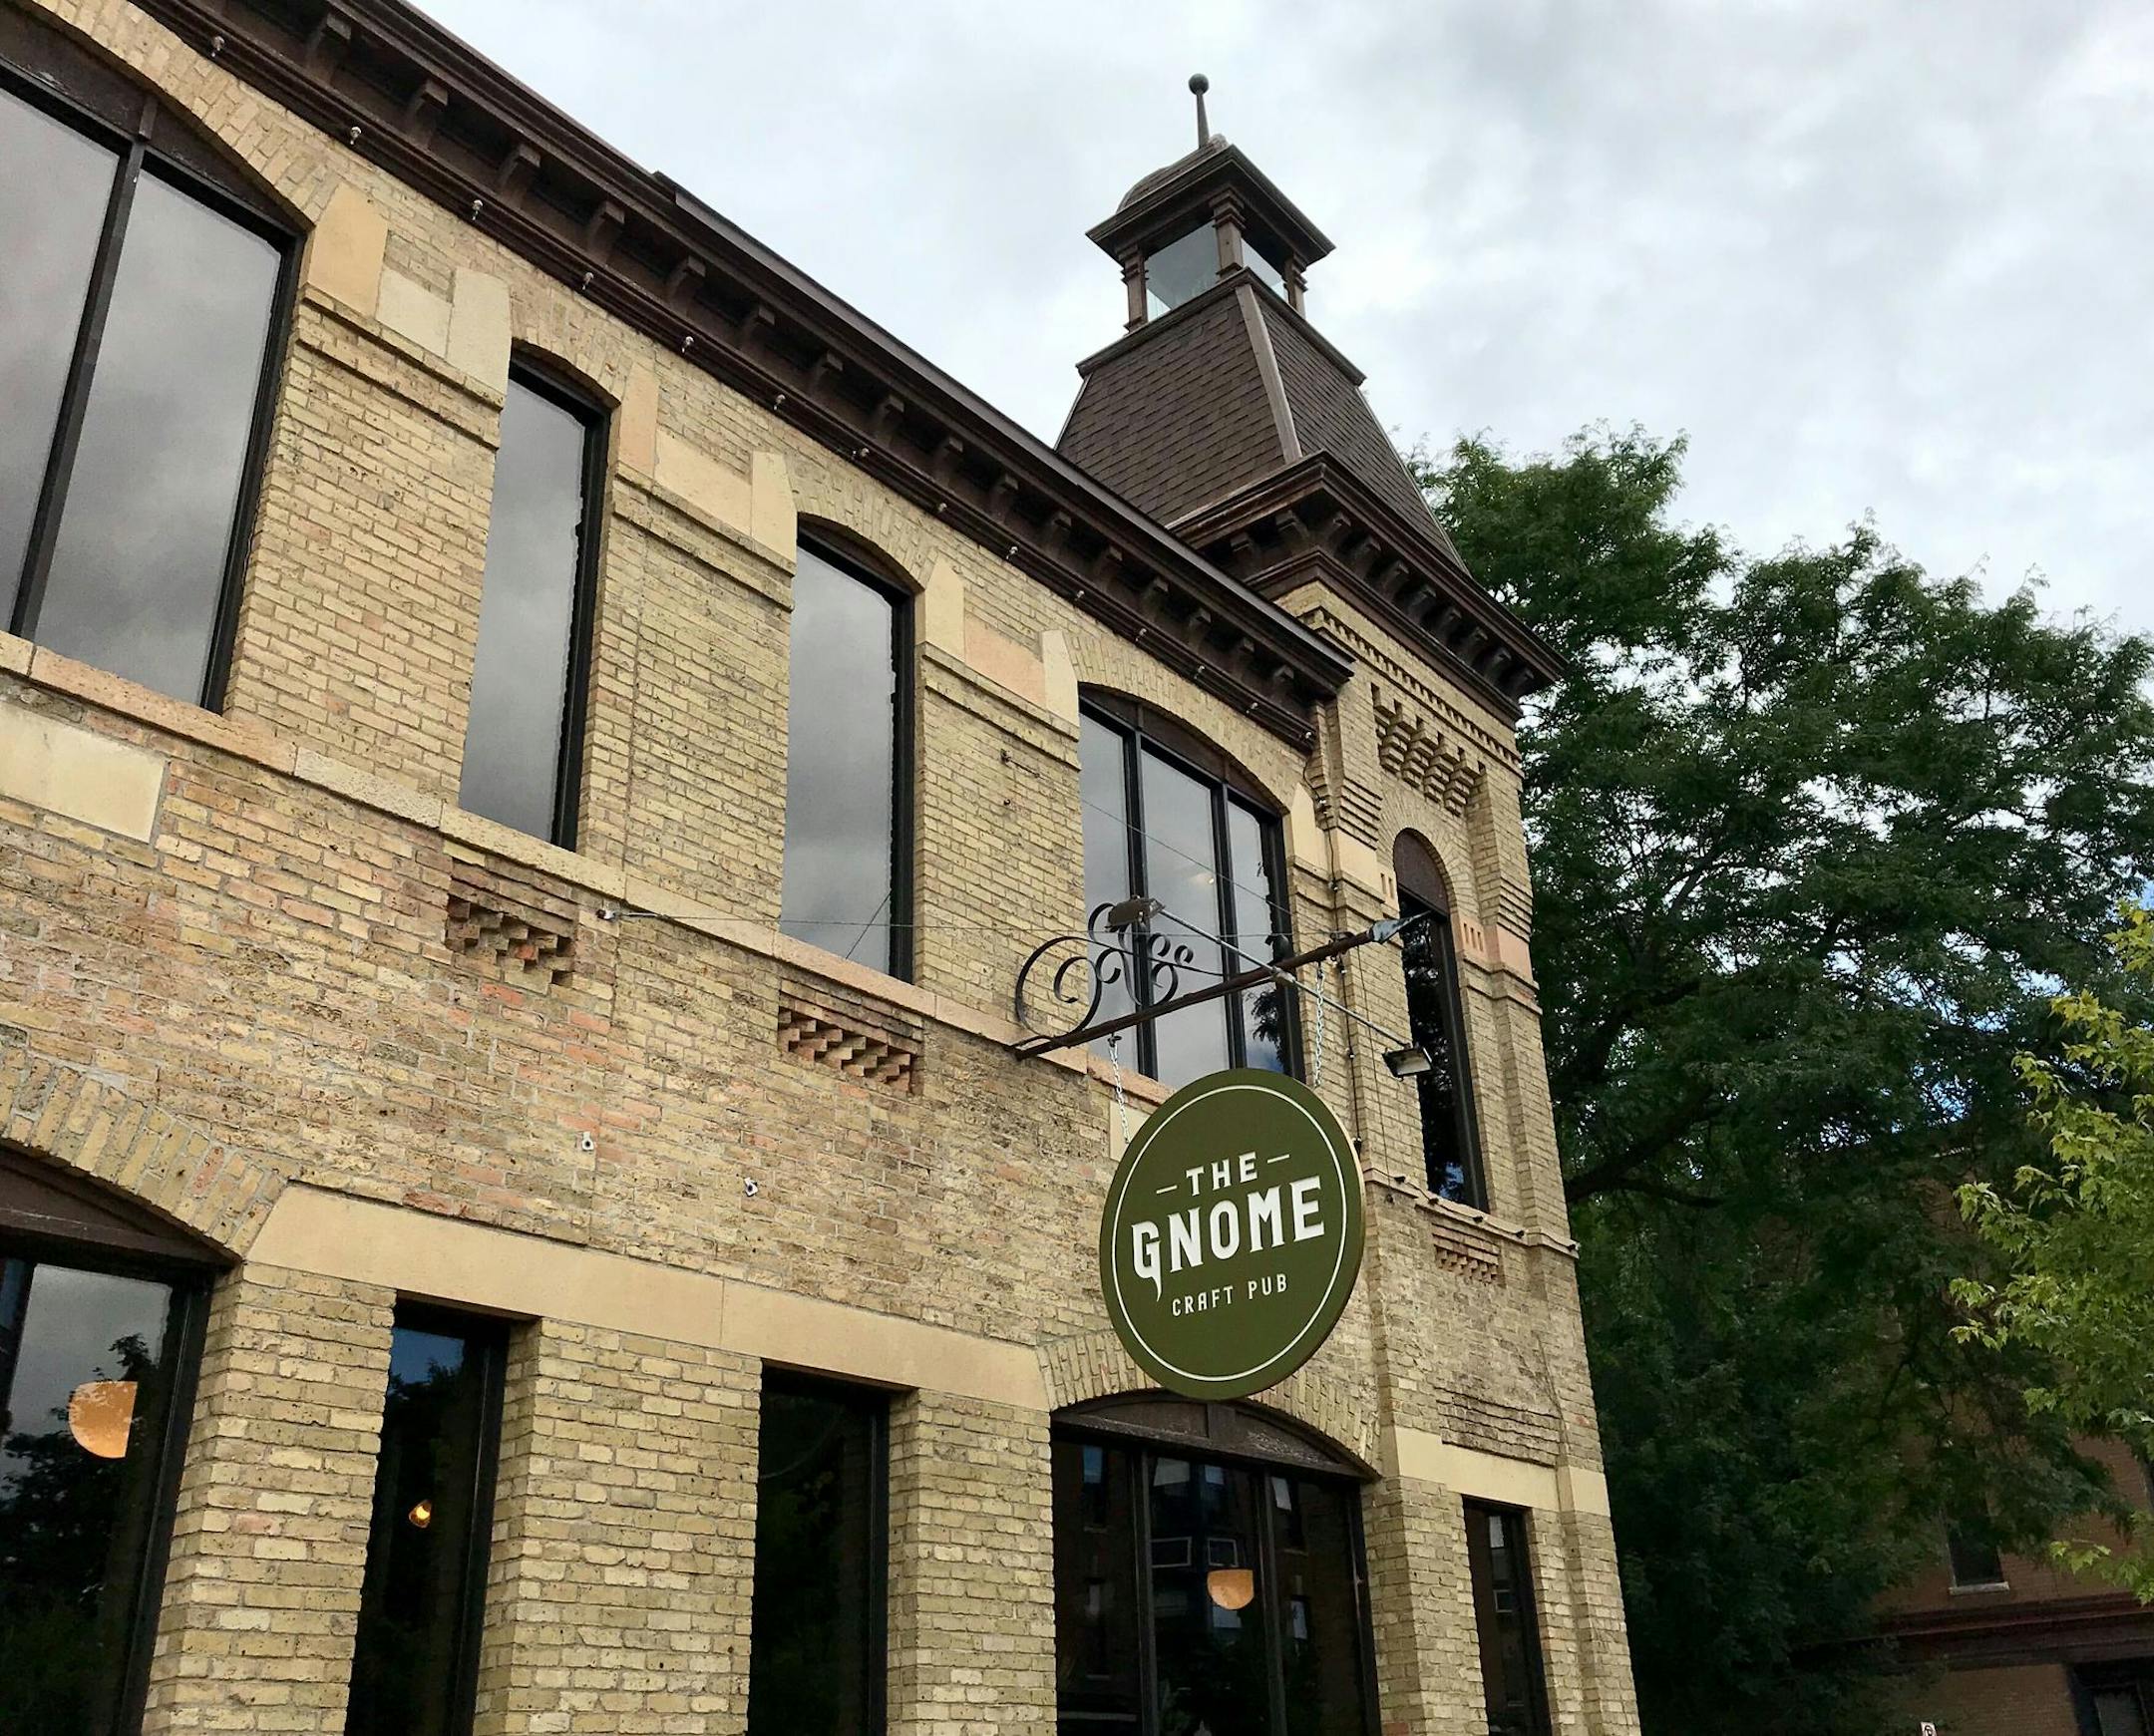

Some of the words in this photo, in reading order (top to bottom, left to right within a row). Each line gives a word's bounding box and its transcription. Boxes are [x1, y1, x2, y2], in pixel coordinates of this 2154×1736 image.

[1186, 1151, 1258, 1197] THE
[1131, 1175, 1325, 1302] GNOME
[1172, 1285, 1235, 1317] CRAFT
[1248, 1273, 1288, 1300] PUB
